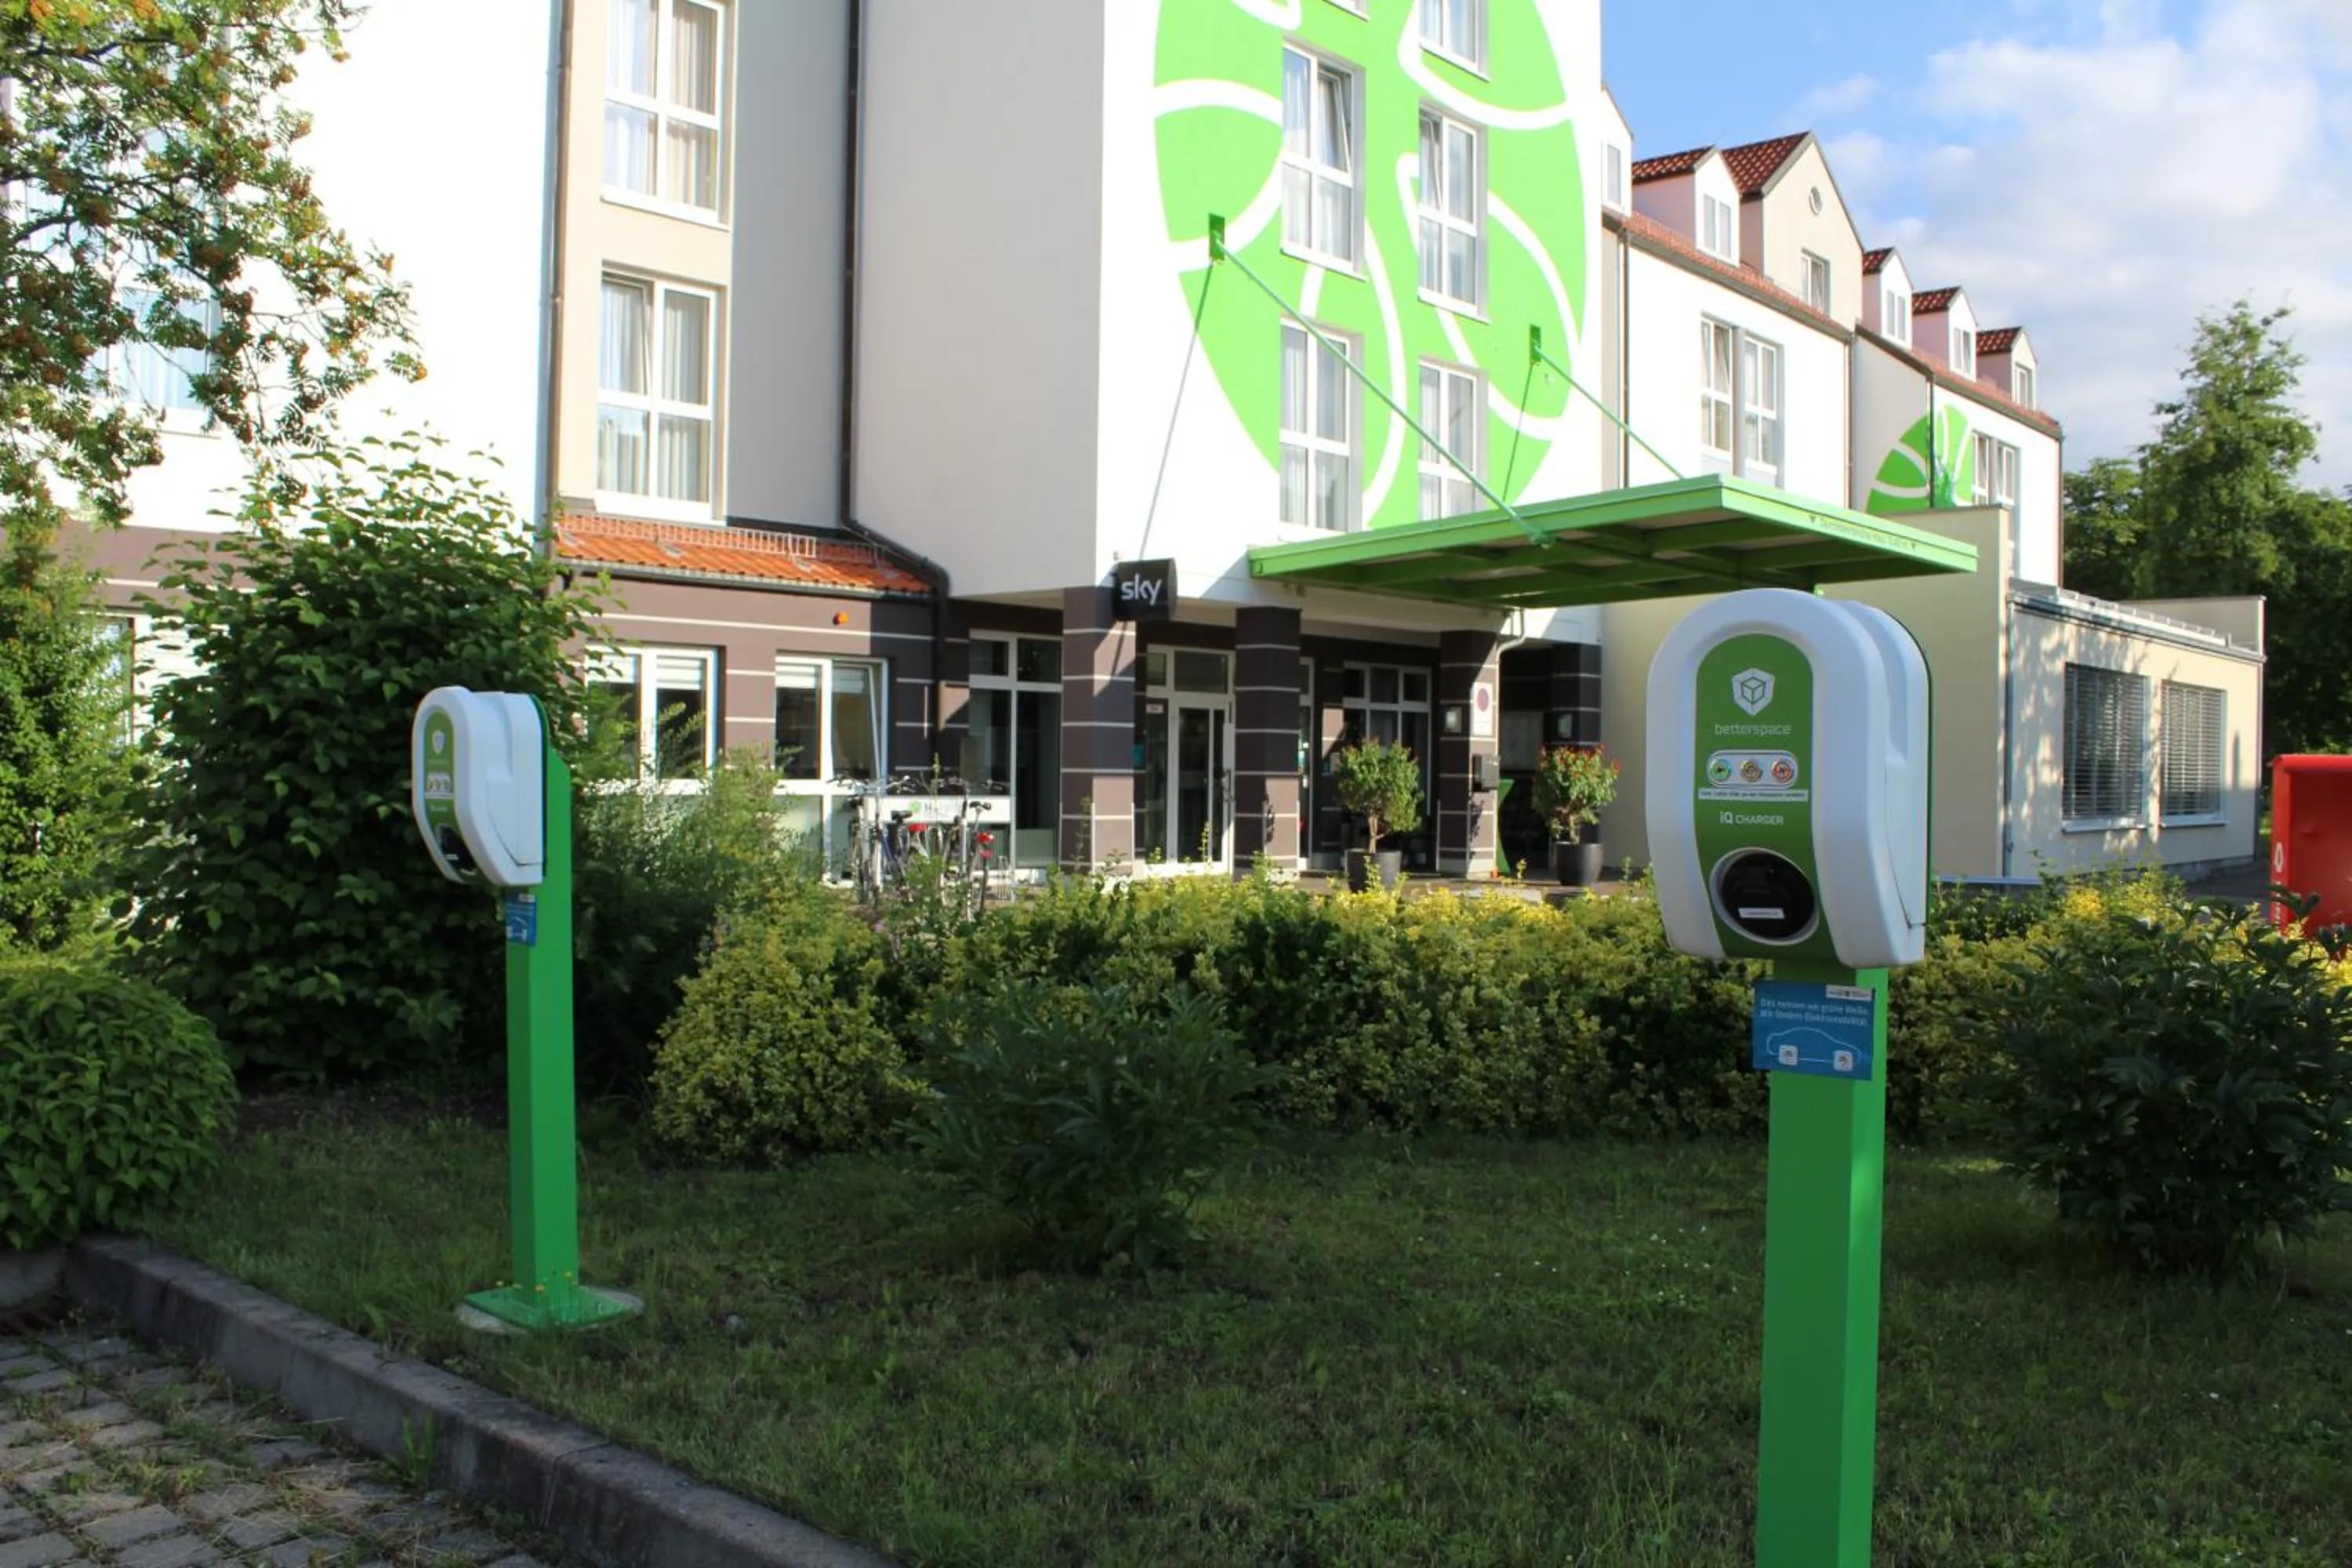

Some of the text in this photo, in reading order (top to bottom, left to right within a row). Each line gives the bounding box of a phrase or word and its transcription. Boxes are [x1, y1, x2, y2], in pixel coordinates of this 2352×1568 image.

[1121, 572, 1162, 606] sky
[1715, 722, 1791, 737] betterspace
[1719, 811, 1784, 826] iQ CHARGER
